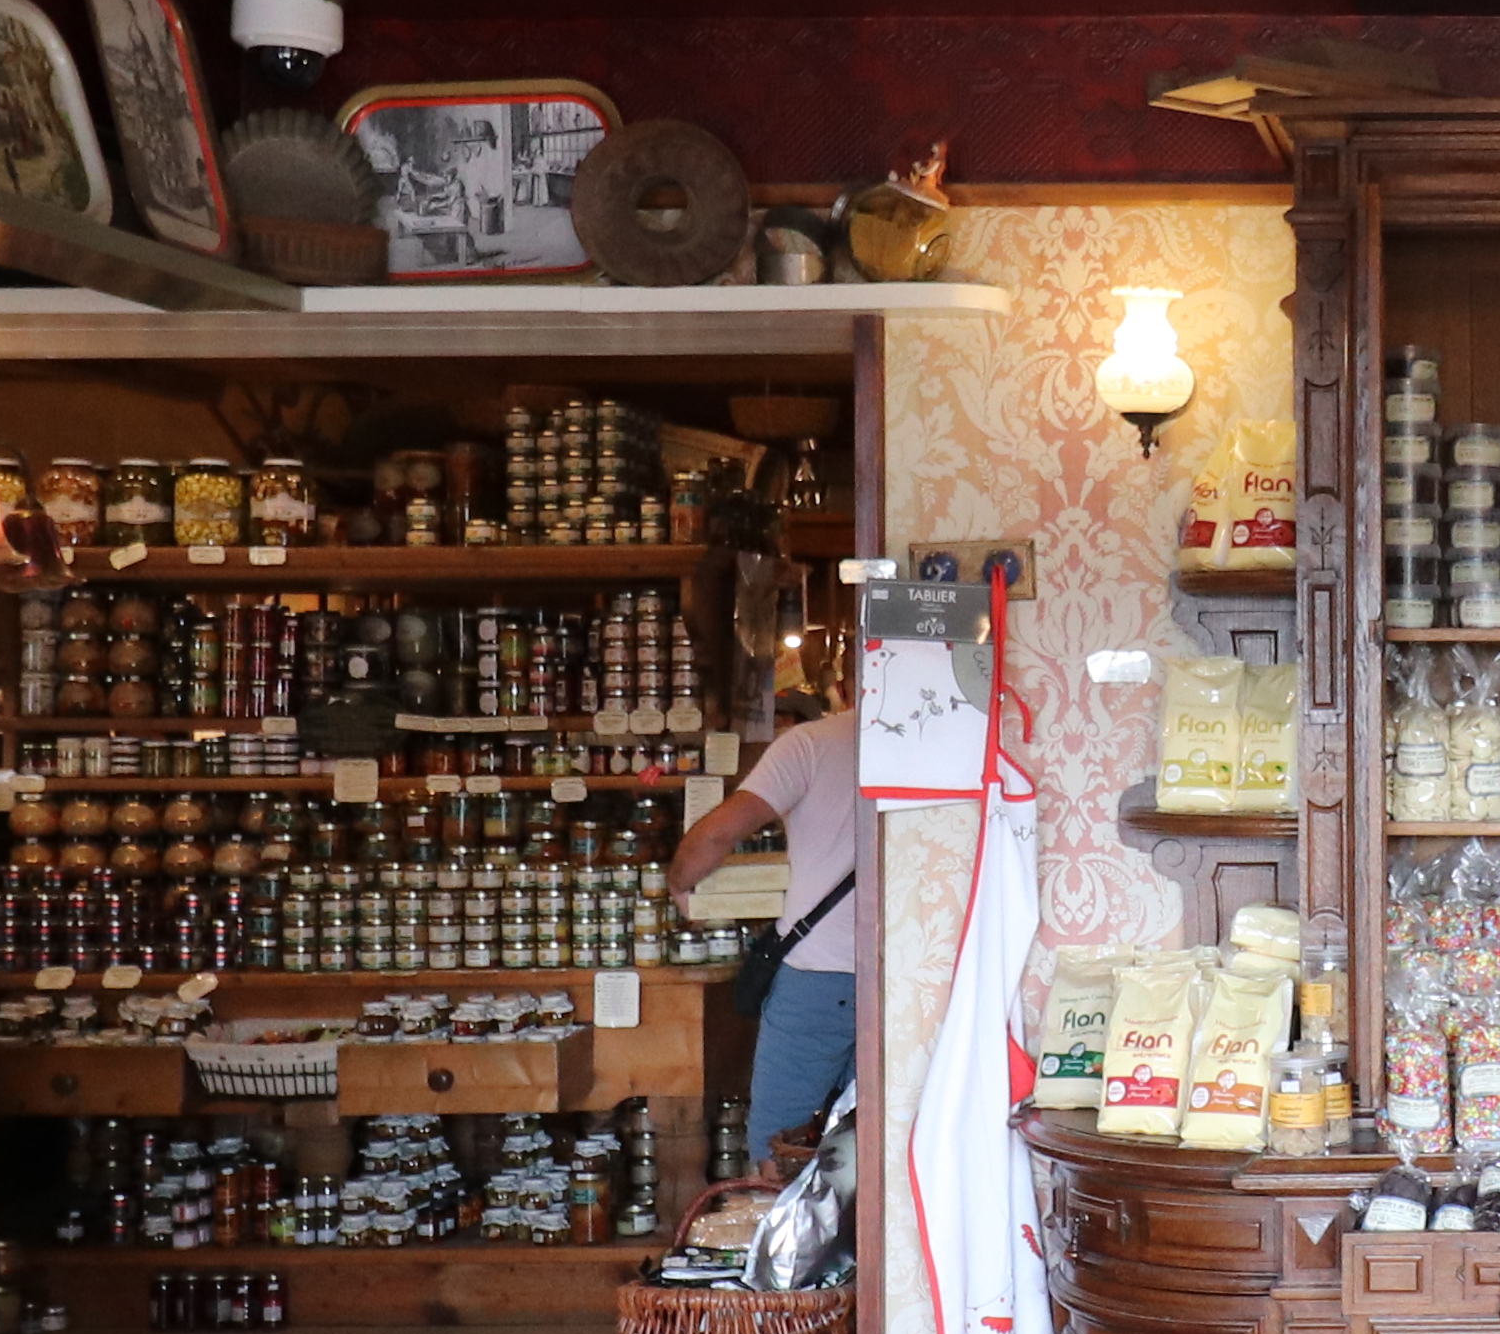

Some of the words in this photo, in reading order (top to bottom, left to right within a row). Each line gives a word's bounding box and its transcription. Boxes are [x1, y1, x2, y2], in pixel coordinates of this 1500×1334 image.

[1244, 471, 1292, 494] flan
[908, 588, 957, 604] TABLIER
[1178, 713, 1227, 735] flan
[1244, 714, 1284, 735] flan
[1063, 1008, 1106, 1032] flan
[1122, 1030, 1174, 1049] flan
[1211, 1033, 1260, 1056] flan
